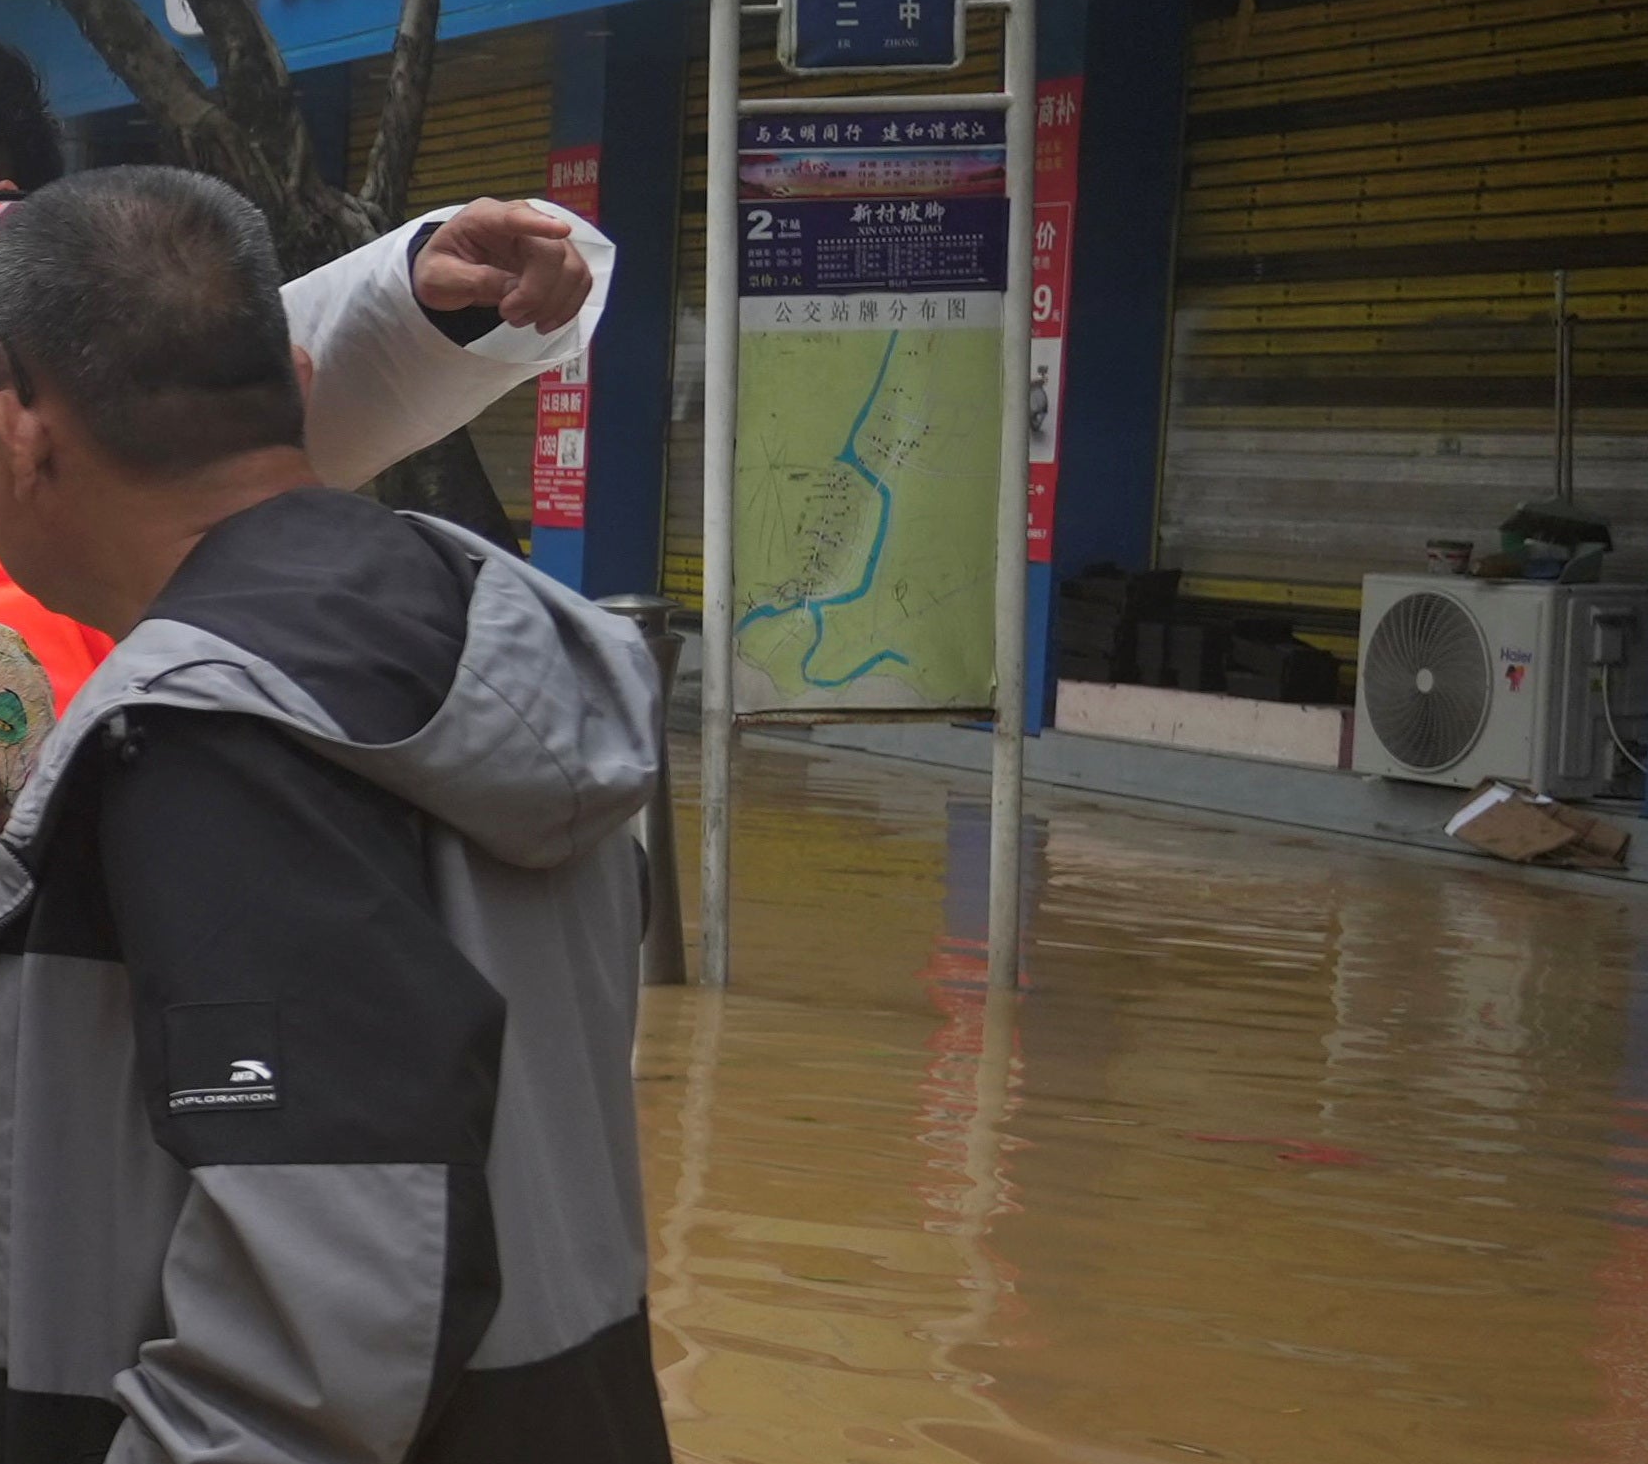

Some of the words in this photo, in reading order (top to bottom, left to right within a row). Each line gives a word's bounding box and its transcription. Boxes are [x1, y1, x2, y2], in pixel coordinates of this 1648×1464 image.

[756, 124, 863, 143] 与文明同行
[849, 201, 946, 223] 新村坡脚
[747, 210, 773, 240] 2
[858, 226, 877, 235] XIN
[879, 225, 901, 234] CUN
[1036, 221, 1056, 250] 价
[775, 298, 966, 324] 公交站牌分布图
[1500, 647, 1532, 663] Haier
